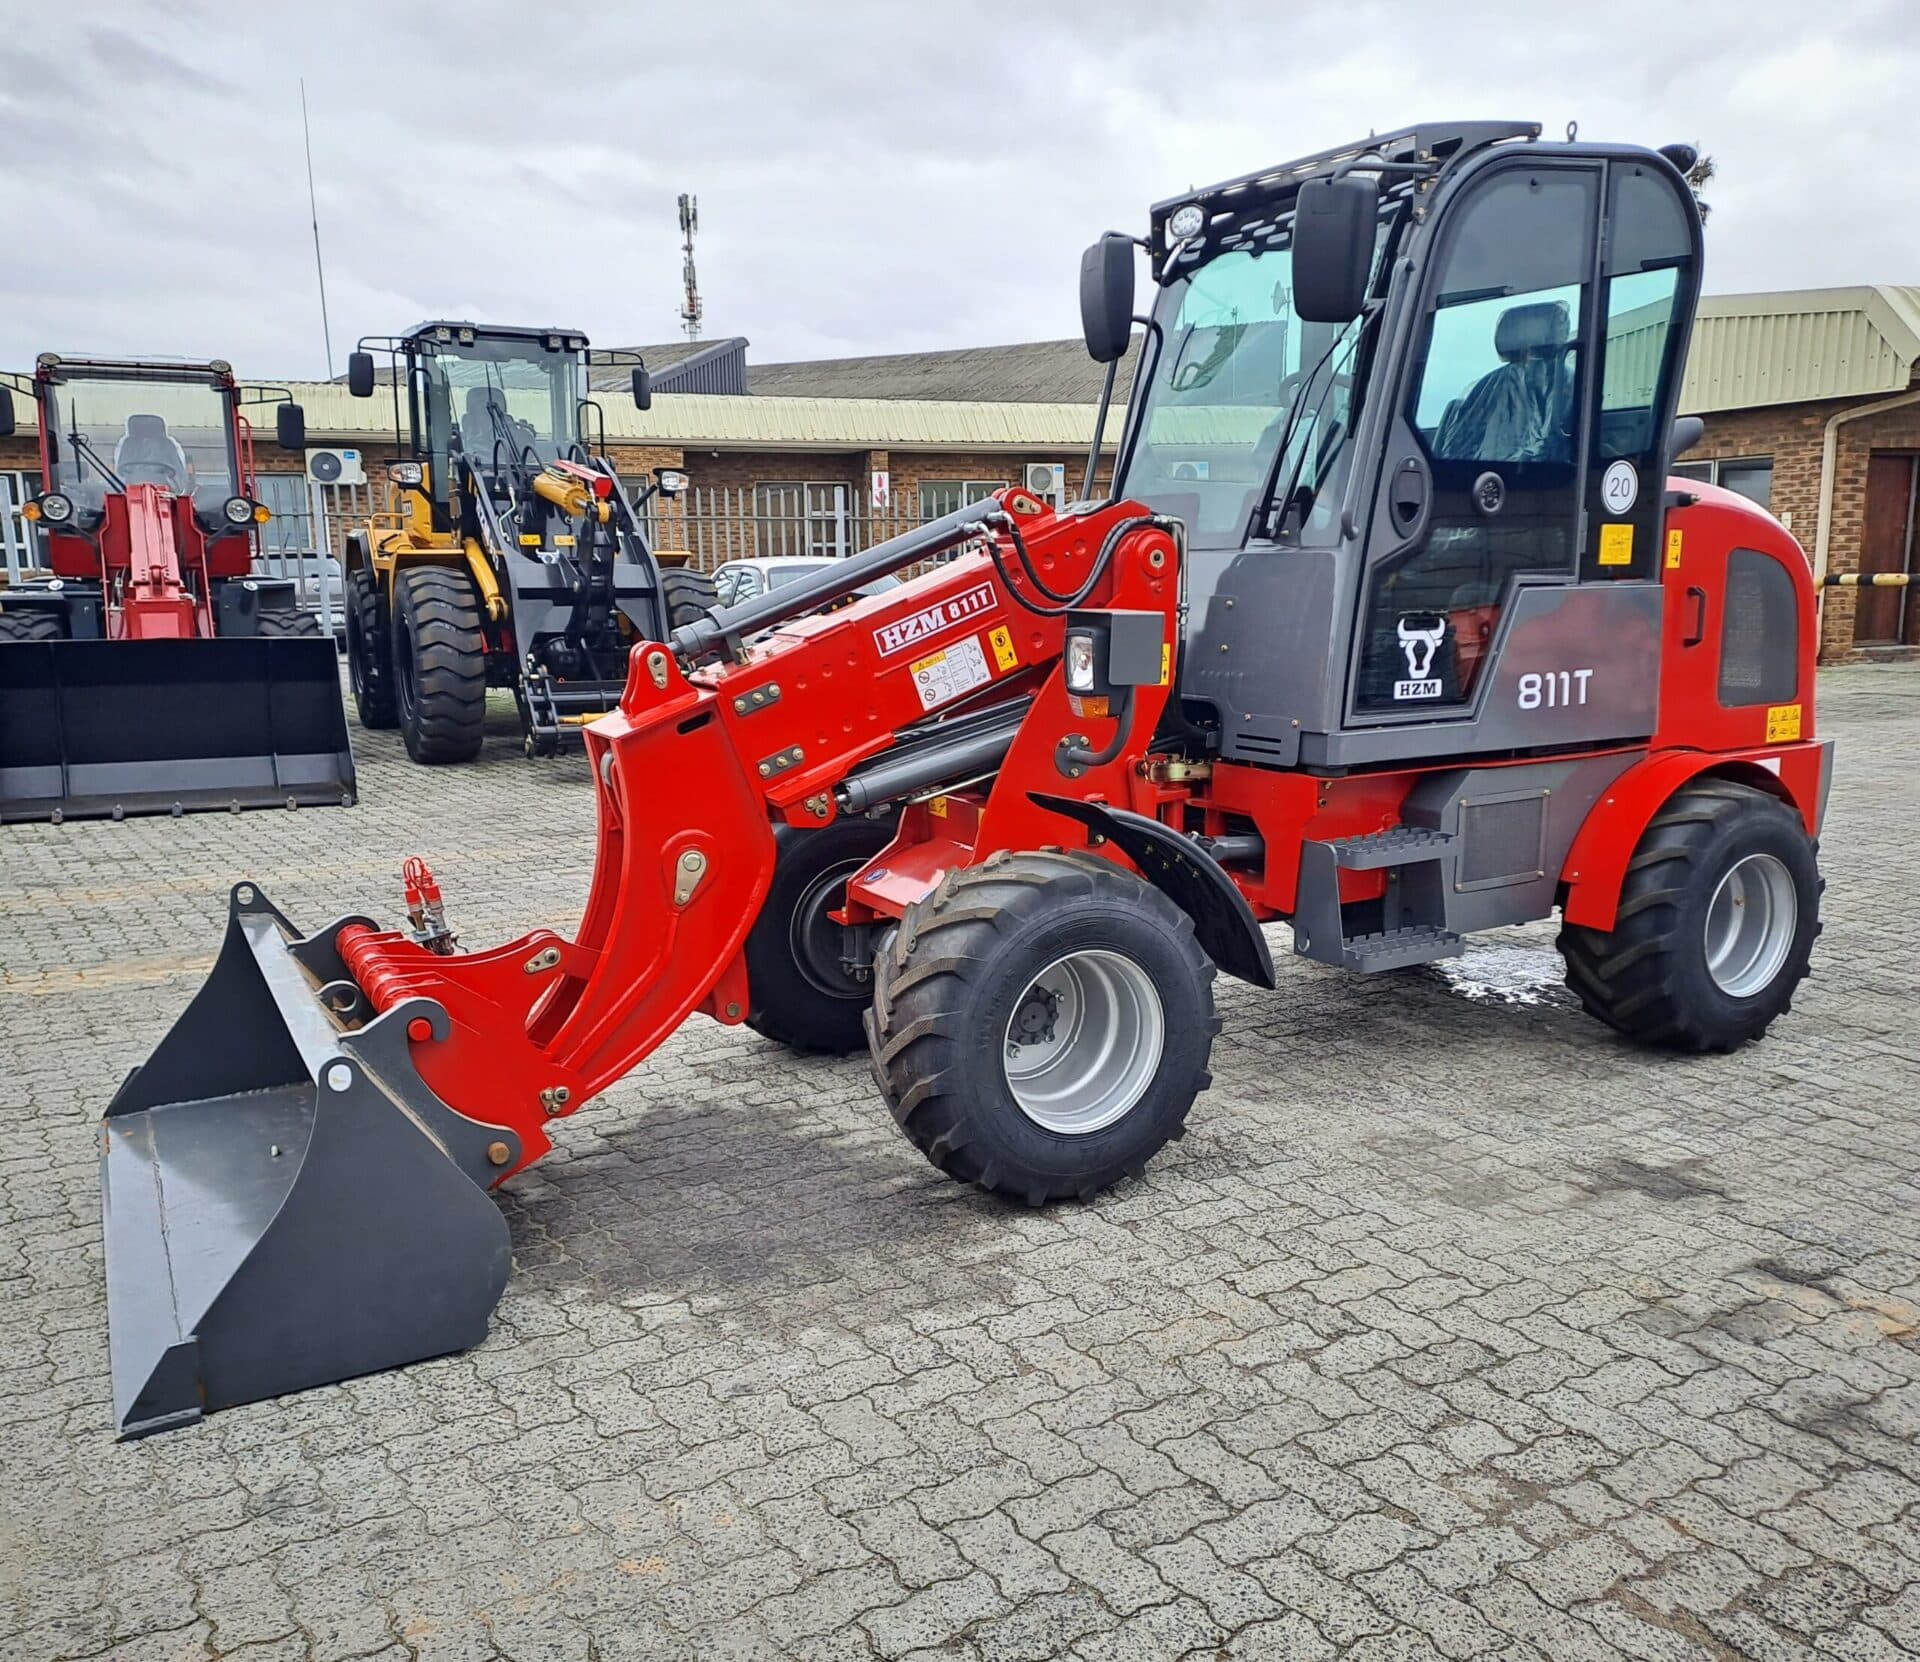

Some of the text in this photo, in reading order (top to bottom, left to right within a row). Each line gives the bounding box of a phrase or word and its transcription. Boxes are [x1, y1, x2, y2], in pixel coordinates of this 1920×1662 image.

[1609, 476, 1631, 498] 20
[880, 588, 989, 651] HZM 811T
[1399, 682, 1438, 697] HZM
[1517, 668, 1593, 710] 811T
